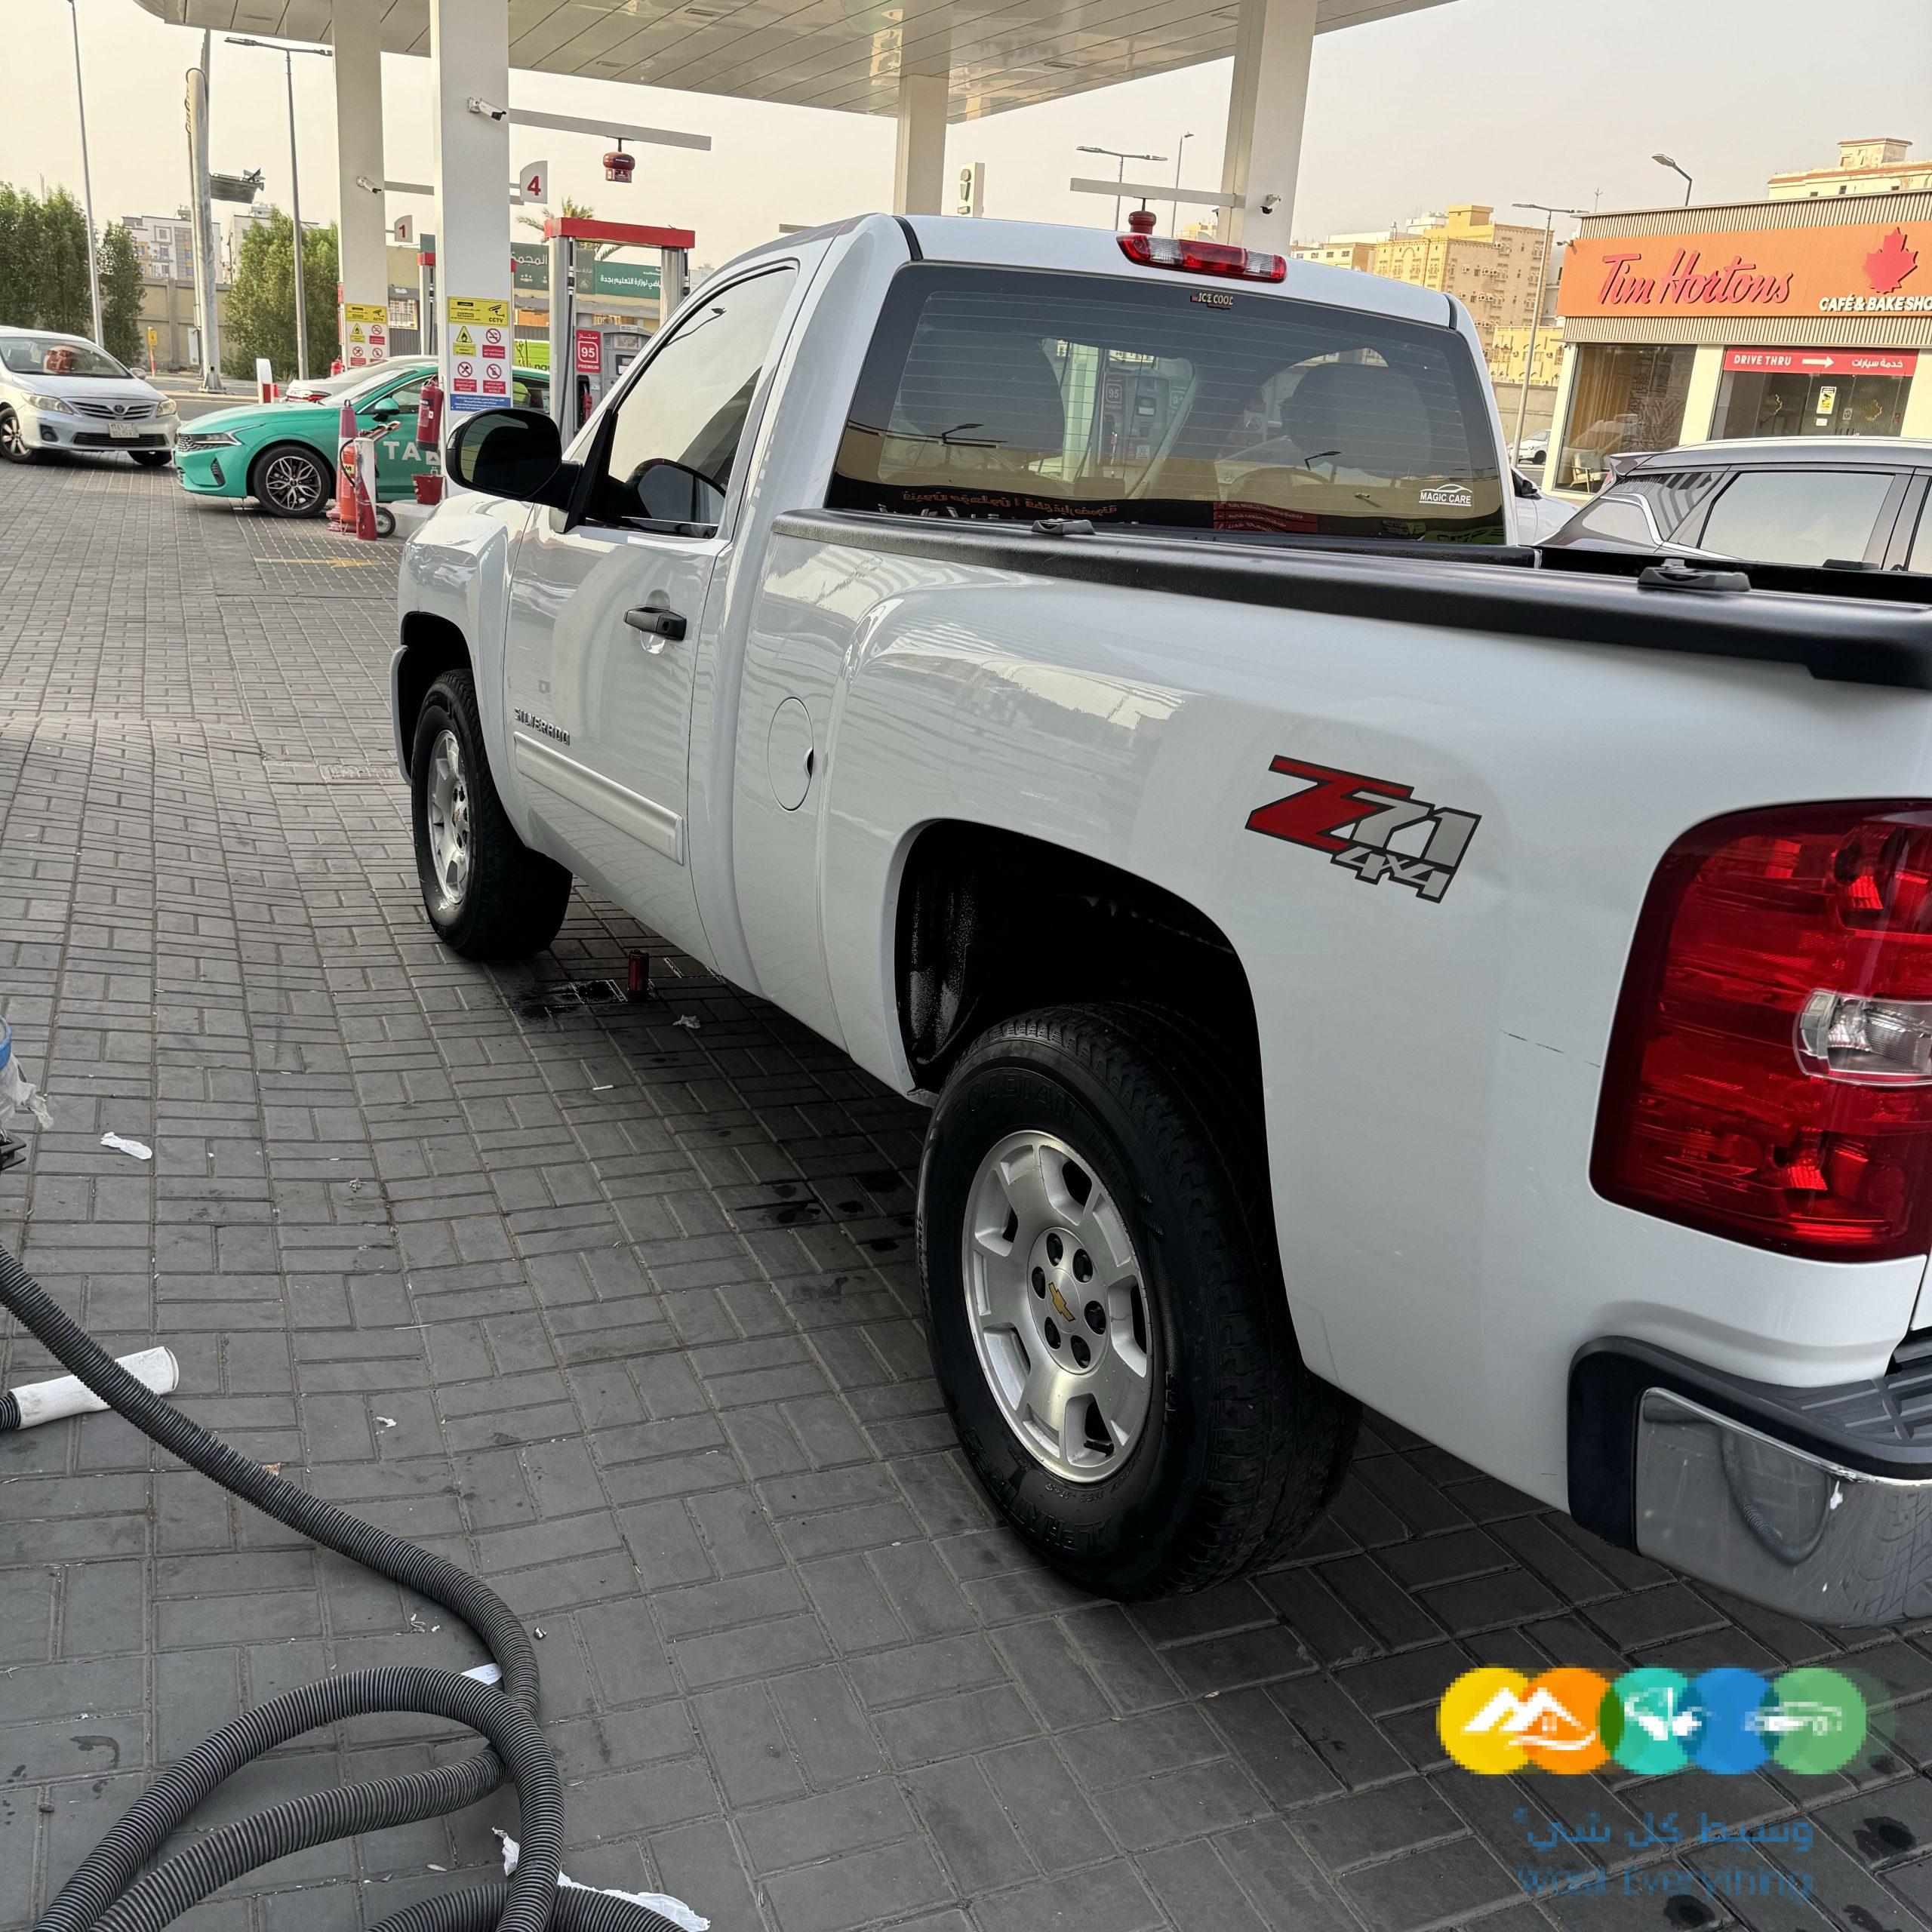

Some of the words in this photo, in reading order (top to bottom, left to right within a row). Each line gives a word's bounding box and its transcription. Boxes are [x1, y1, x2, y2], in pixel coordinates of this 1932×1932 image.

[528, 176, 541, 195] 4
[399, 225, 405, 238] 1
[1598, 254, 1655, 304] Tim
[1657, 248, 1793, 304] Hortons
[1198, 293, 1212, 303] ICE
[1214, 294, 1233, 305] COOL
[1819, 294, 1855, 312] CAFÉ
[581, 346, 595, 358] 95
[1734, 355, 1762, 365] DRIVE
[1764, 355, 1792, 366] THRU
[1851, 358, 1879, 368] سيارات
[1879, 358, 1903, 368] خدمة
[1108, 389, 1120, 398] 95
[1420, 492, 1447, 502] MAGIC
[1448, 494, 1472, 504] CARE
[515, 708, 570, 746] SILVERADO
[1244, 755, 1482, 869] Z71
